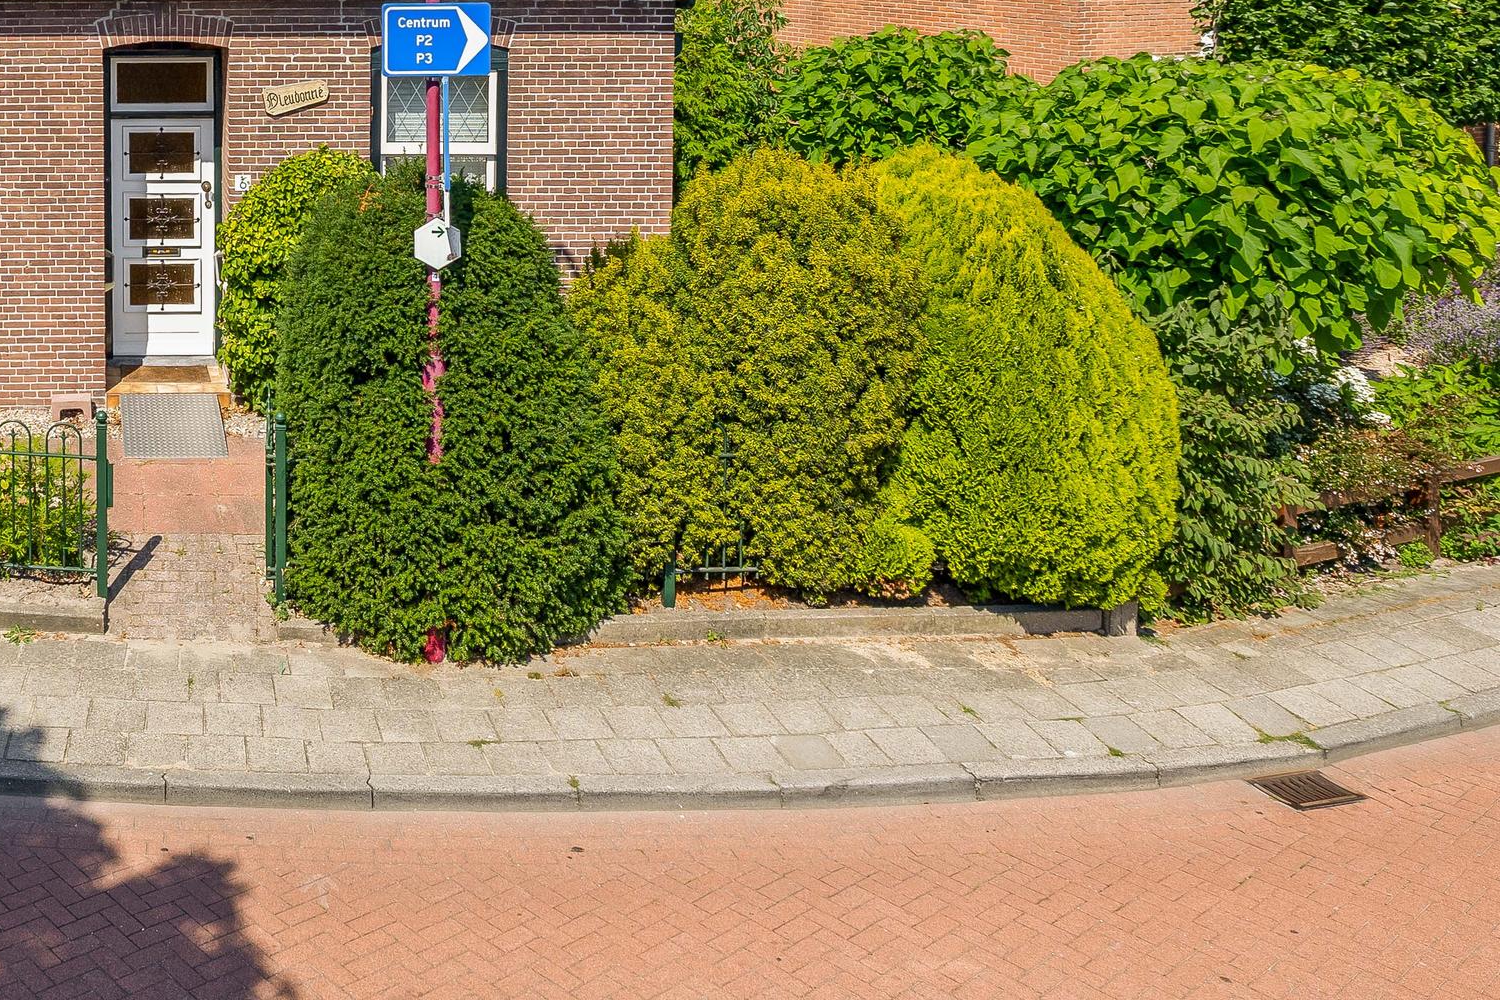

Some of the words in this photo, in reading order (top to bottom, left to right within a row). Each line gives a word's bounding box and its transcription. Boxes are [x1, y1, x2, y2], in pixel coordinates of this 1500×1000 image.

[397, 16, 451, 29] Centrum
[415, 34, 433, 47] P2
[415, 52, 433, 65] P3
